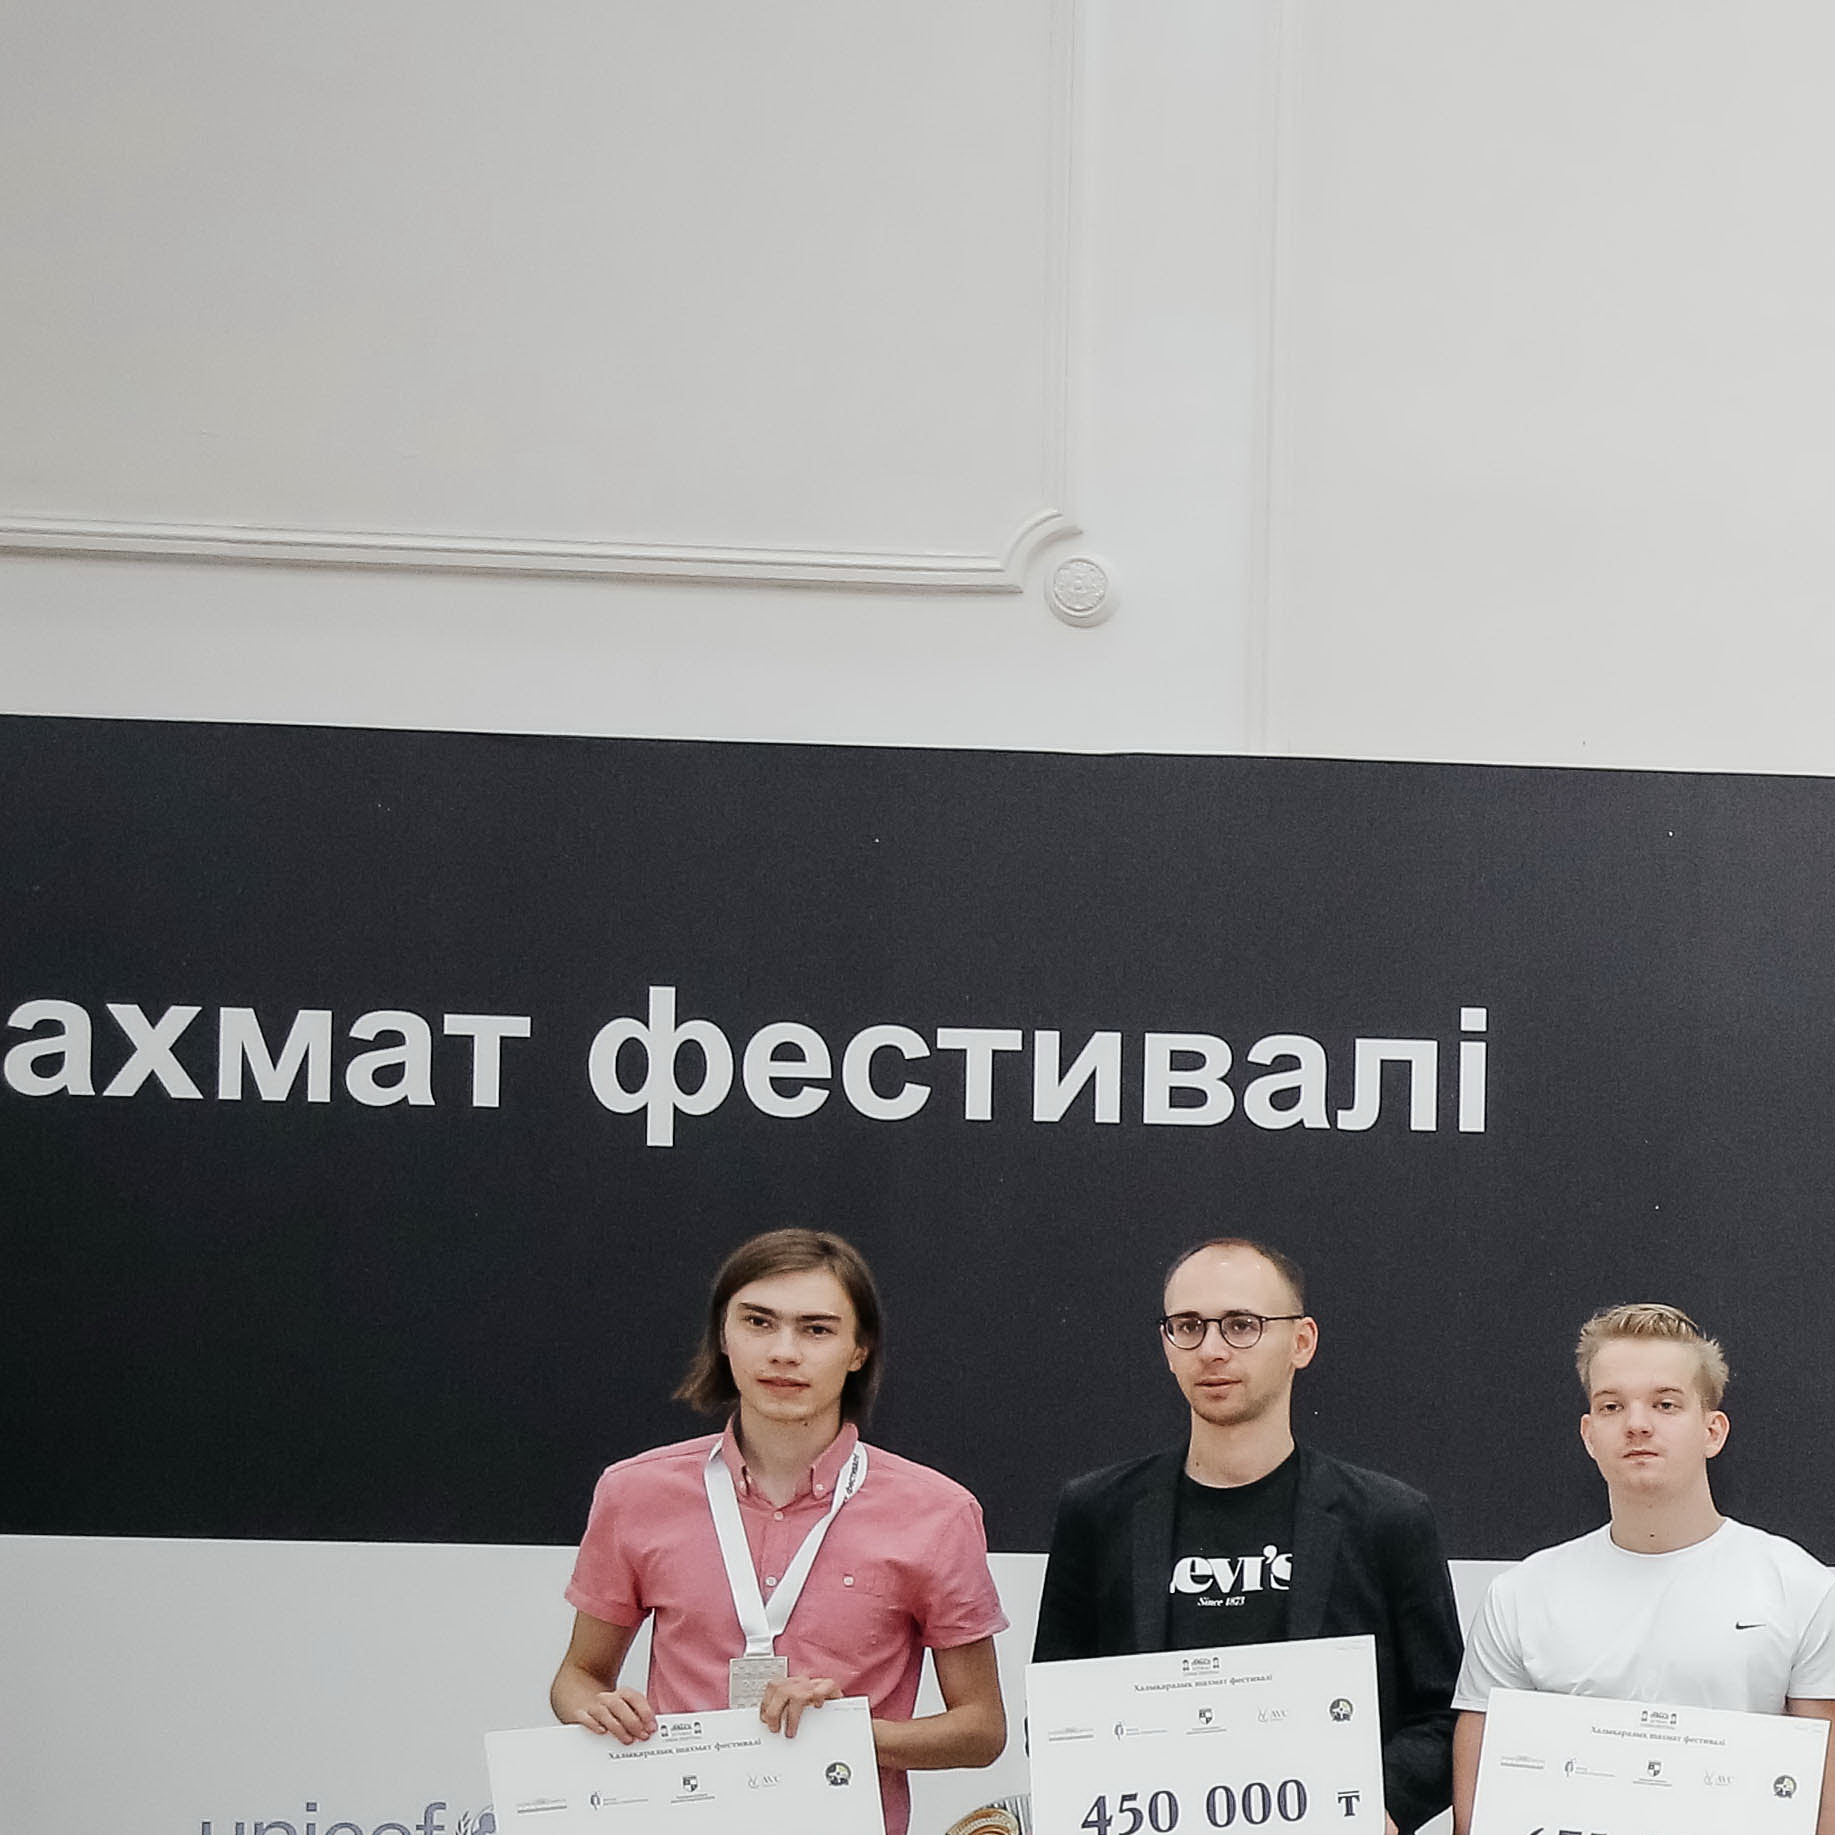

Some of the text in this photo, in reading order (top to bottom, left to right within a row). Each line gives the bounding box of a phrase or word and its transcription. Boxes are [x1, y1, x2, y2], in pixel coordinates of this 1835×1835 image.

[3, 985, 1488, 1147] ахмат фестивалі
[1206, 1779, 1307, 1828] 000
